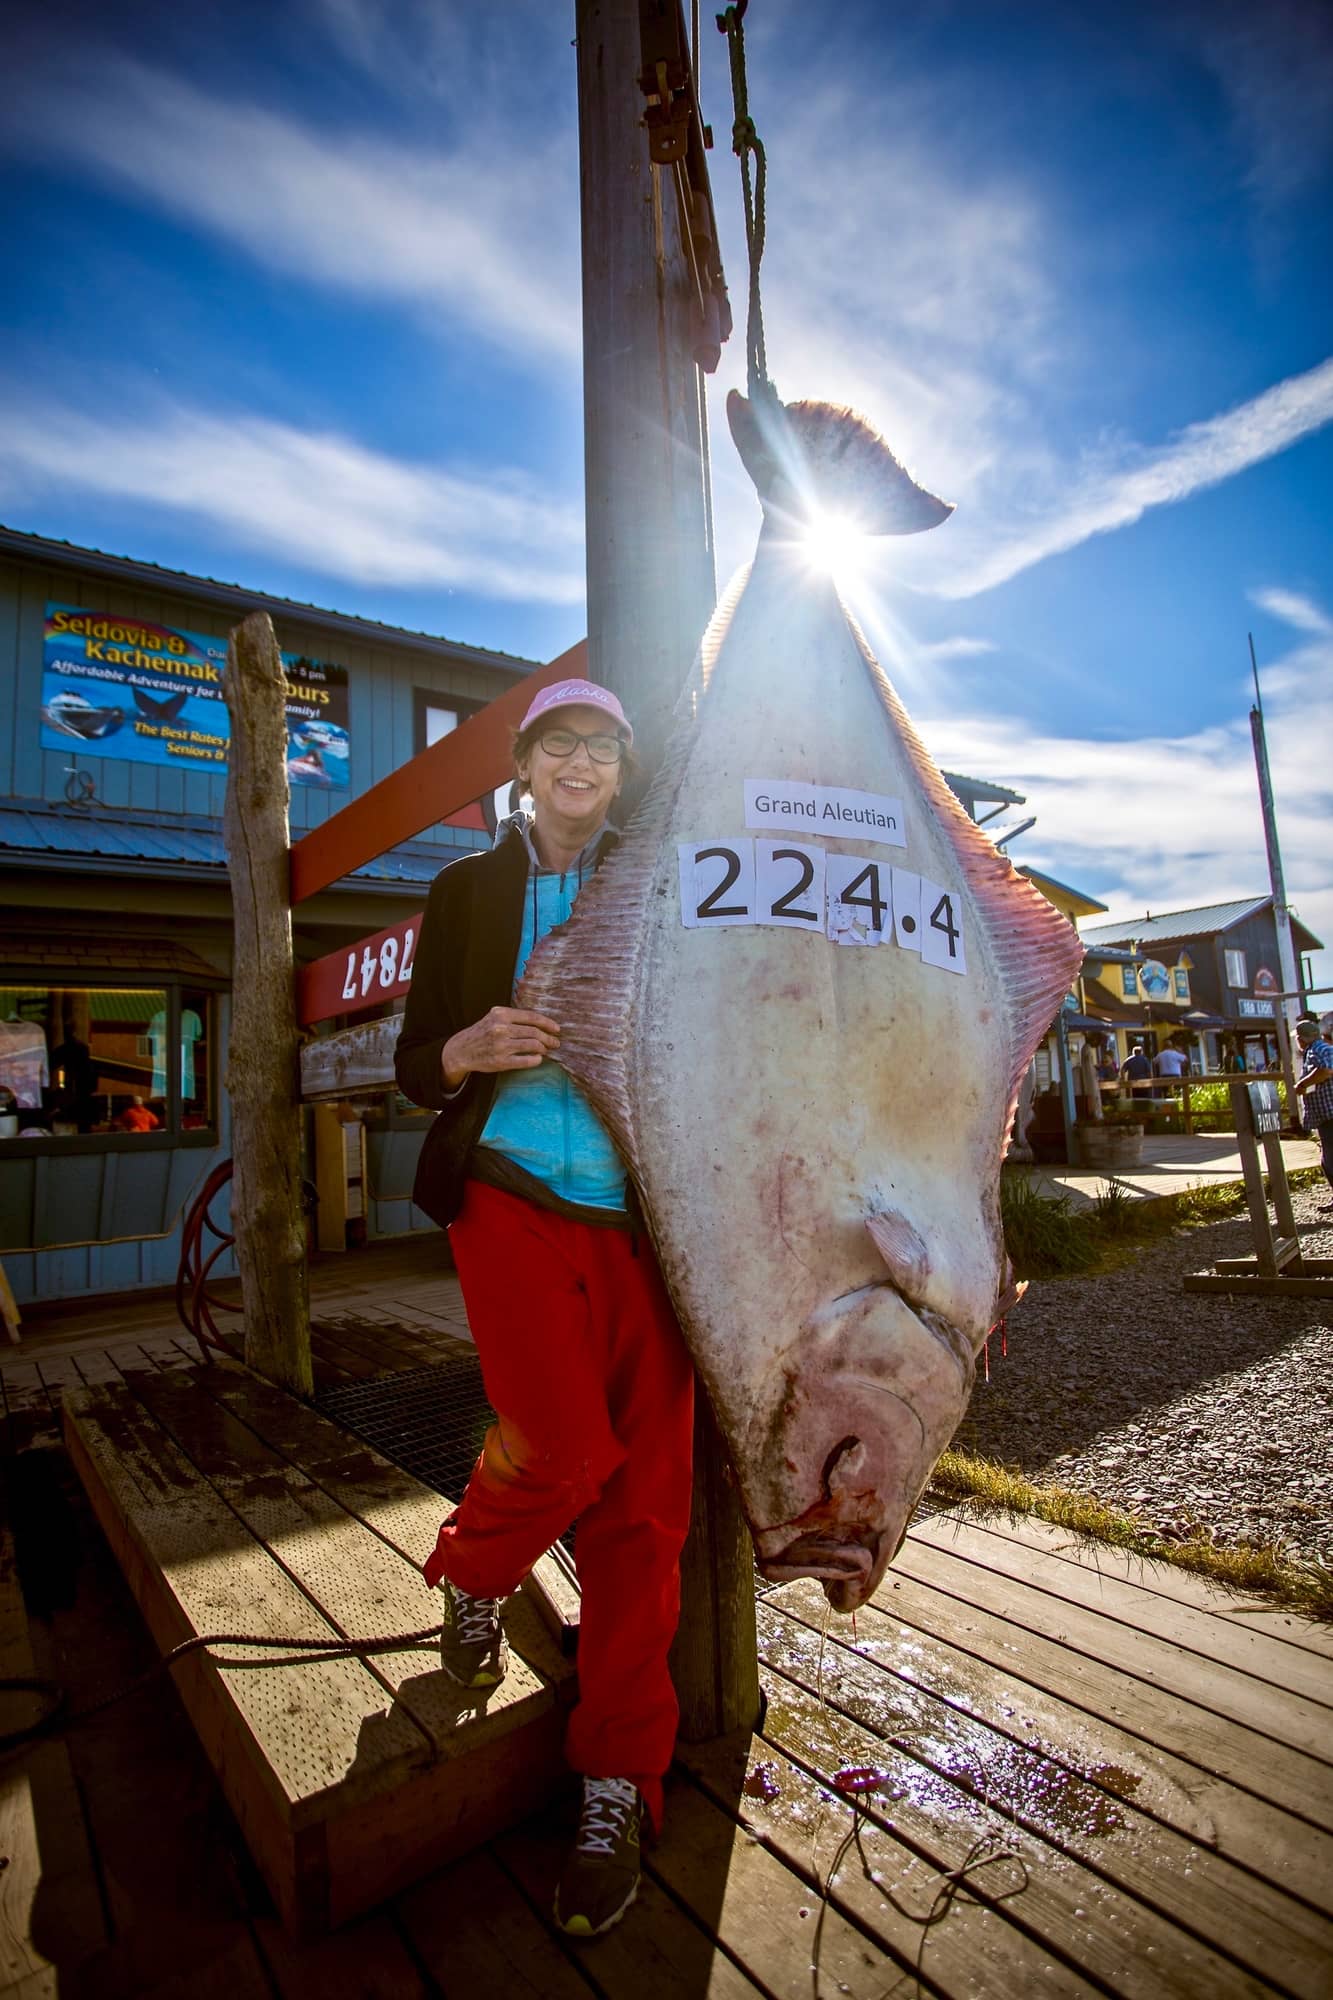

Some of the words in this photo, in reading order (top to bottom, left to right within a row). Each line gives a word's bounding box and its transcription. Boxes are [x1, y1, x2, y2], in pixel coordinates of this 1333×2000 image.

[53, 611, 161, 651] Seldovia
[167, 635, 186, 656] &
[86, 639, 219, 682] Kachemak
[51, 660, 125, 682] Affordable
[127, 673, 193, 694] Adventure
[195, 685, 215, 697] for
[286, 682, 330, 704] ours
[543, 685, 610, 706] Alaska
[284, 703, 321, 719] amily!
[135, 721, 159, 736] The
[161, 726, 188, 740] Best
[167, 742, 212, 759] Seniors
[754, 795, 816, 817] Grand
[822, 801, 897, 830] Aleutian
[694, 847, 960, 958] 224.4
[342, 928, 414, 999] 7847
